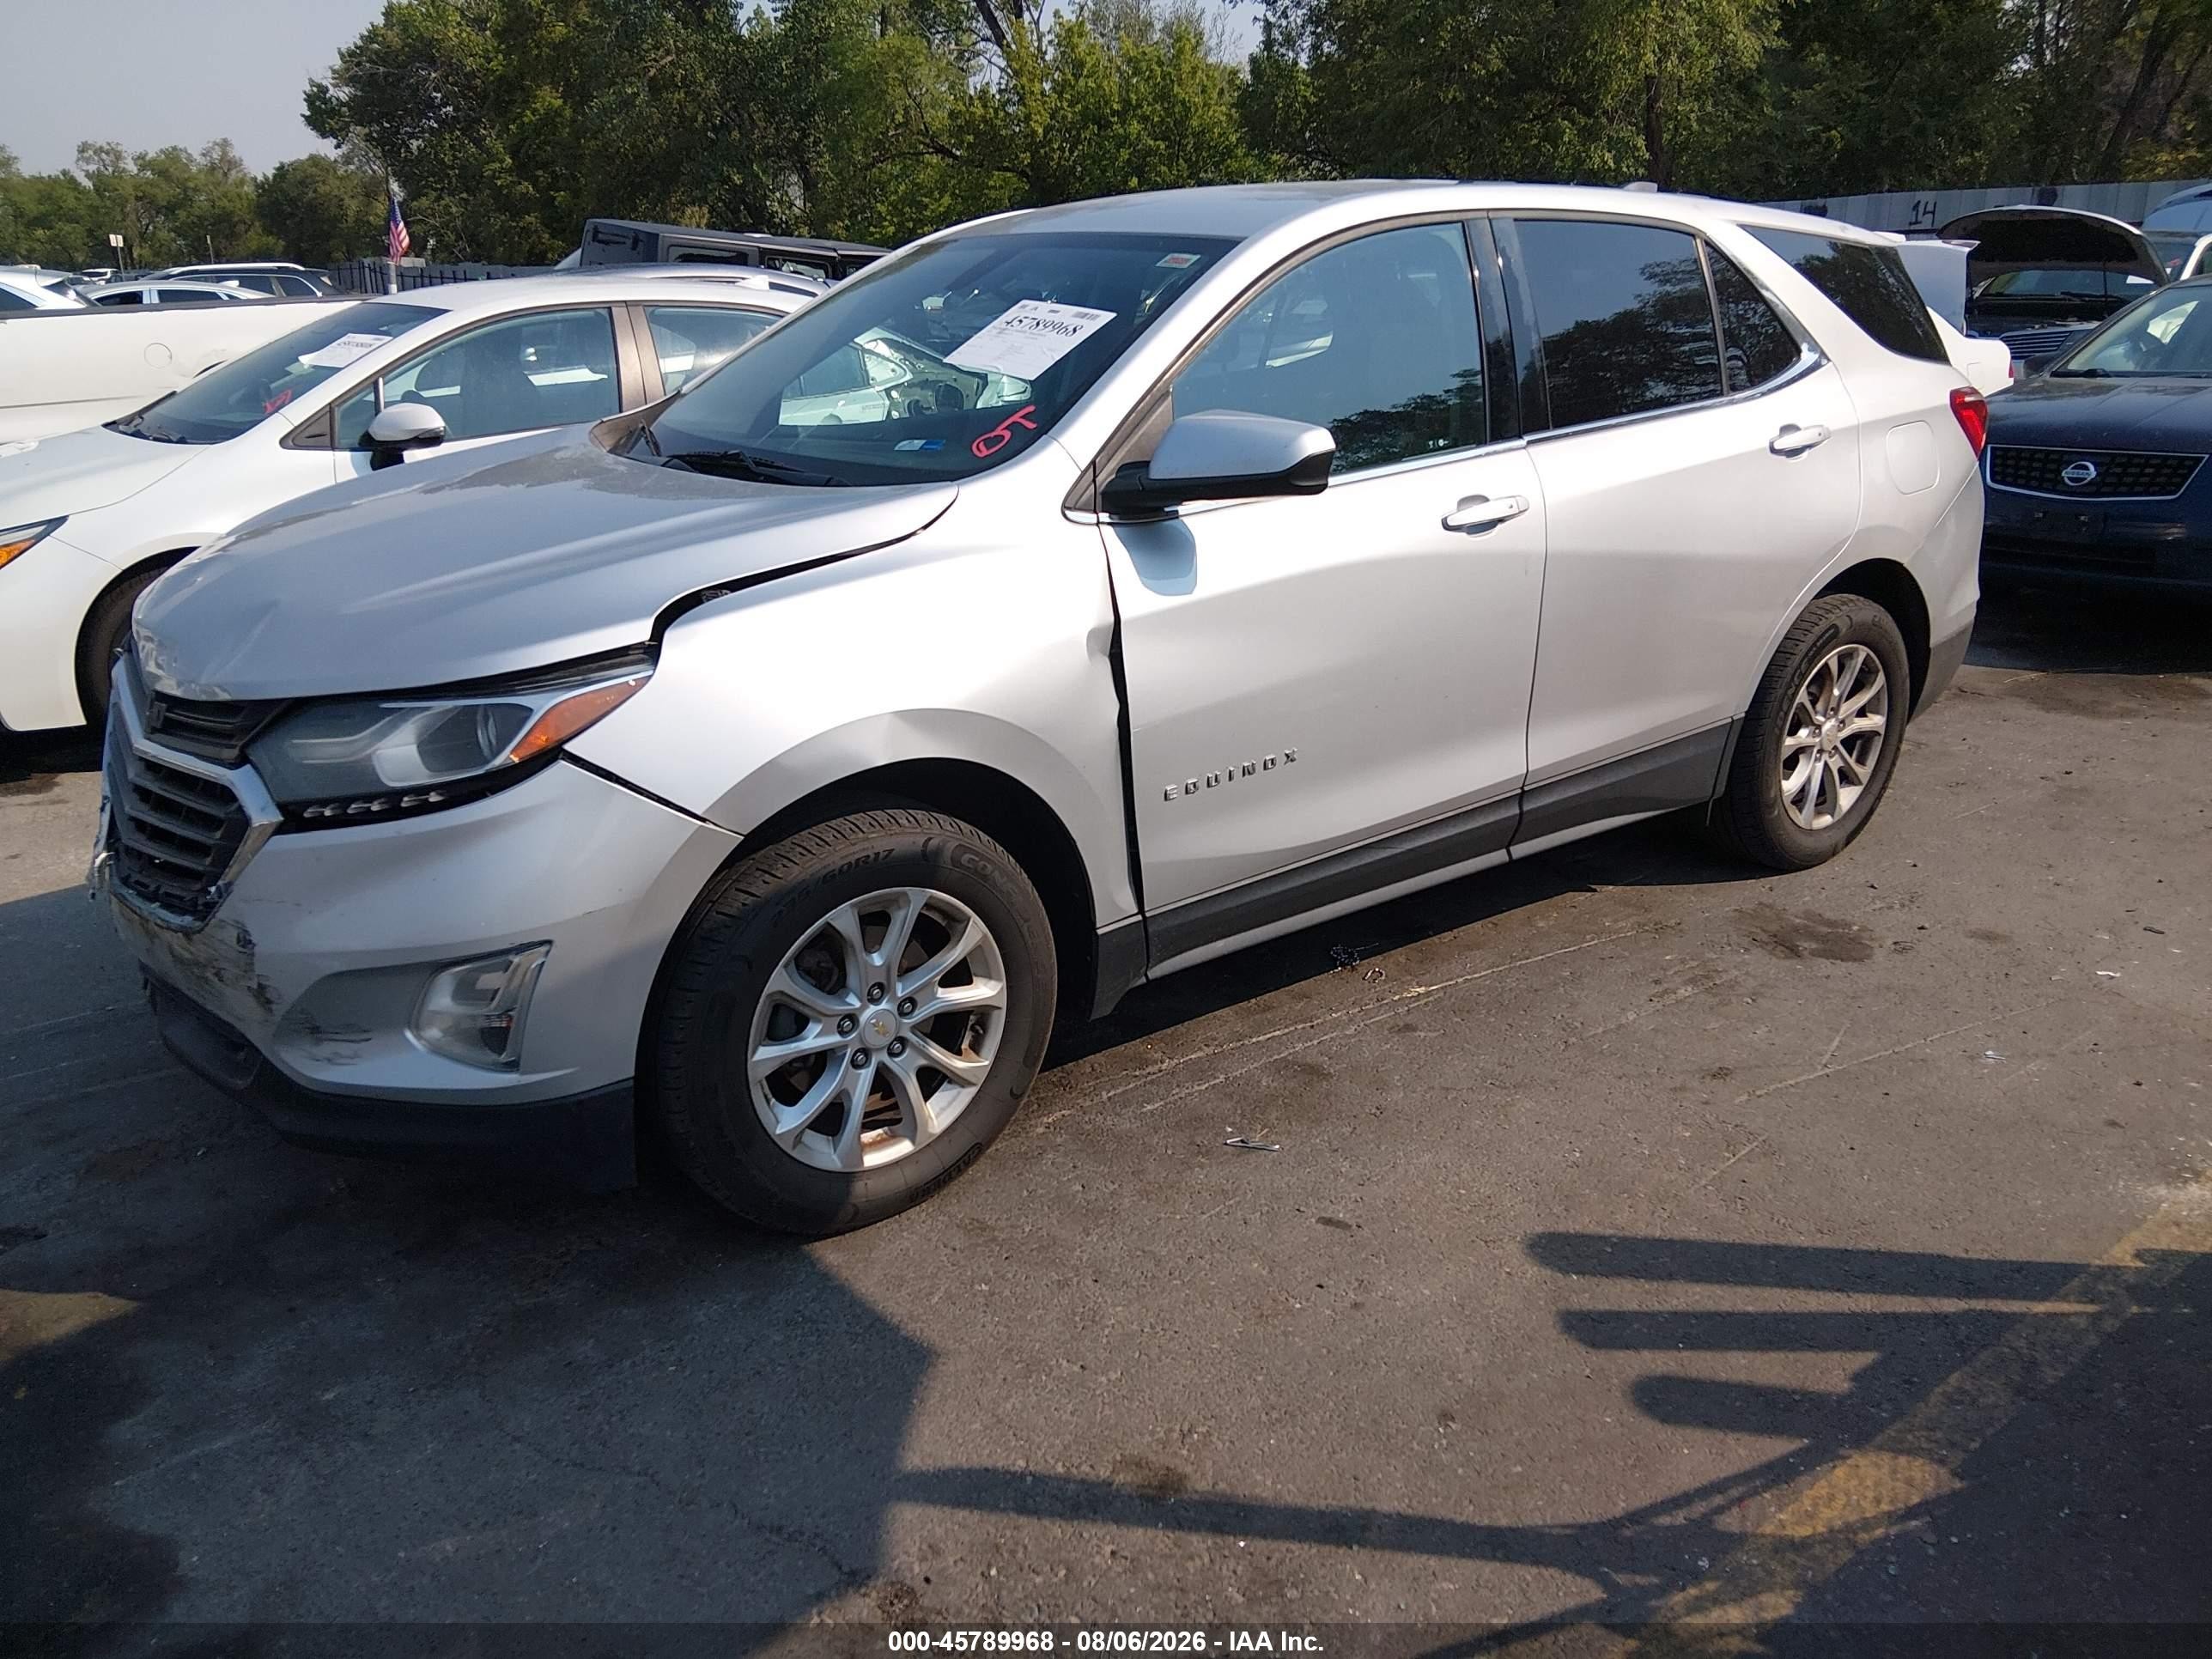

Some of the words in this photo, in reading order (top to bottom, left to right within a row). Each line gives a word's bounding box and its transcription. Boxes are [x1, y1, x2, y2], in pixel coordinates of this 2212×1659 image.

[1909, 200, 1937, 228] 14
[1004, 315, 1084, 337] 45789968
[1164, 747, 1298, 802] EQUINOX
